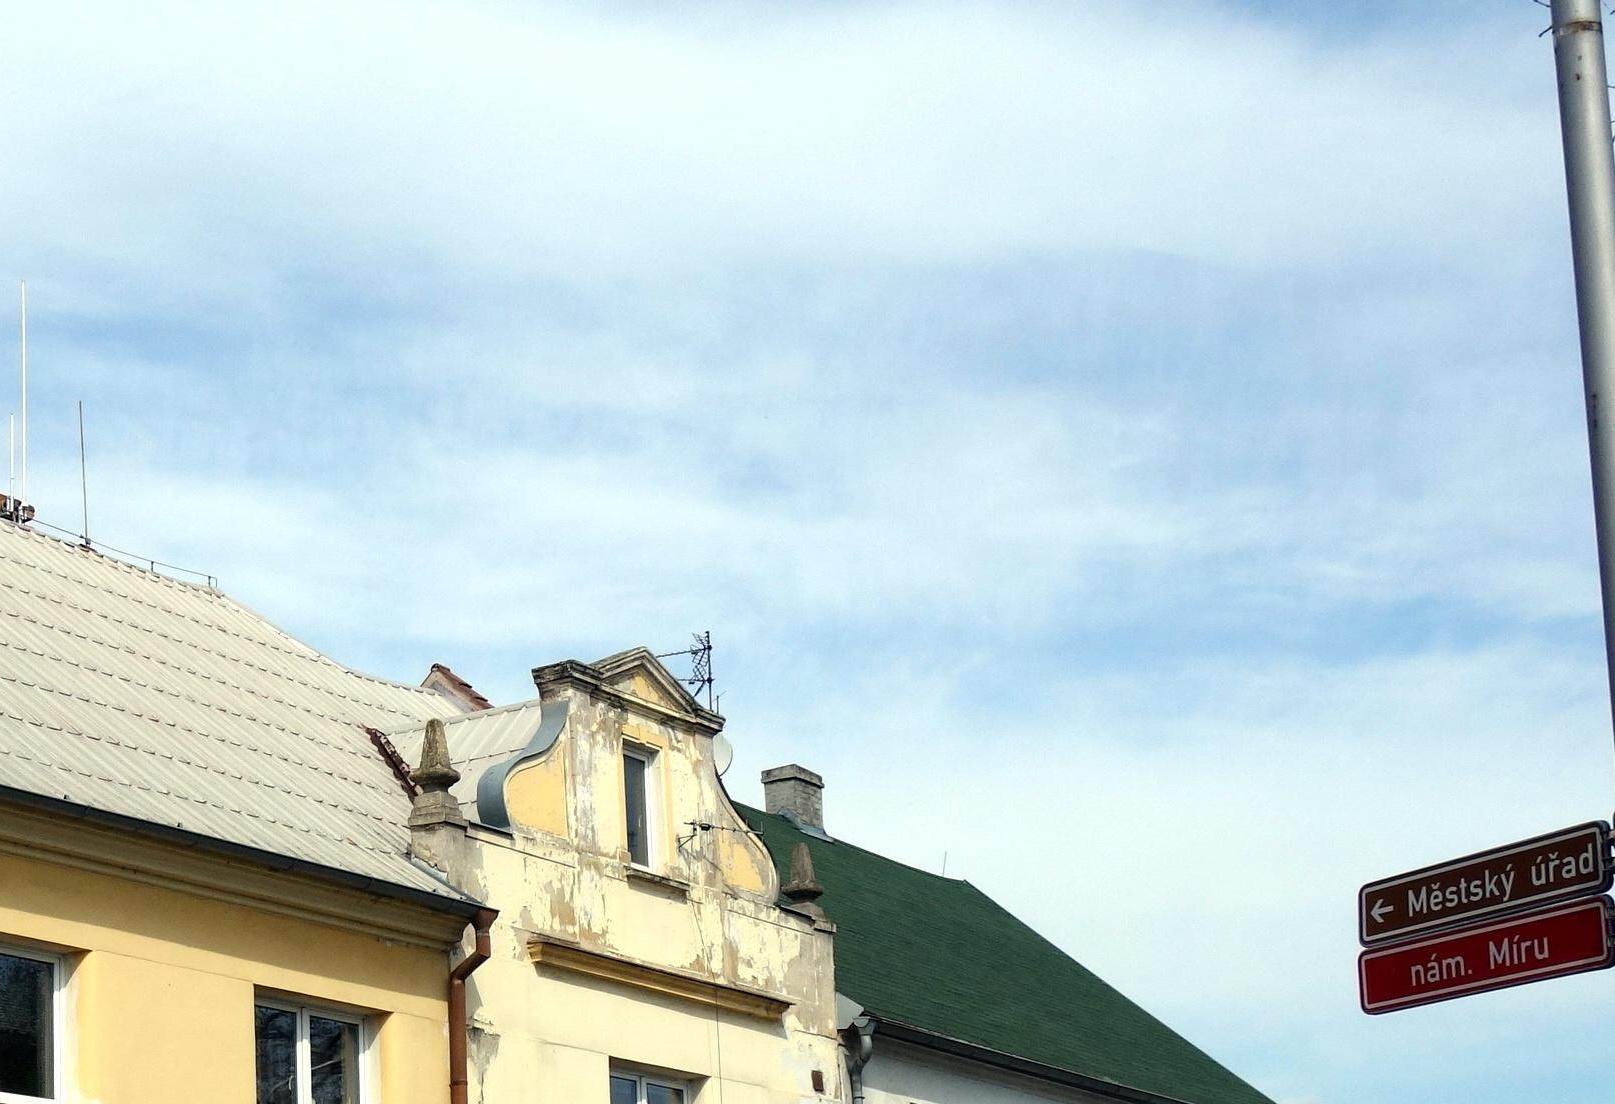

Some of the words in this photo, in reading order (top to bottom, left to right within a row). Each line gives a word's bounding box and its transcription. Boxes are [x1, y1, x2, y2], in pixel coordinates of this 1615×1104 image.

[1408, 863, 1515, 917] Městský
[1530, 842, 1595, 886] úřad
[1410, 952, 1473, 986] nám.
[1488, 935, 1550, 970] Míru
